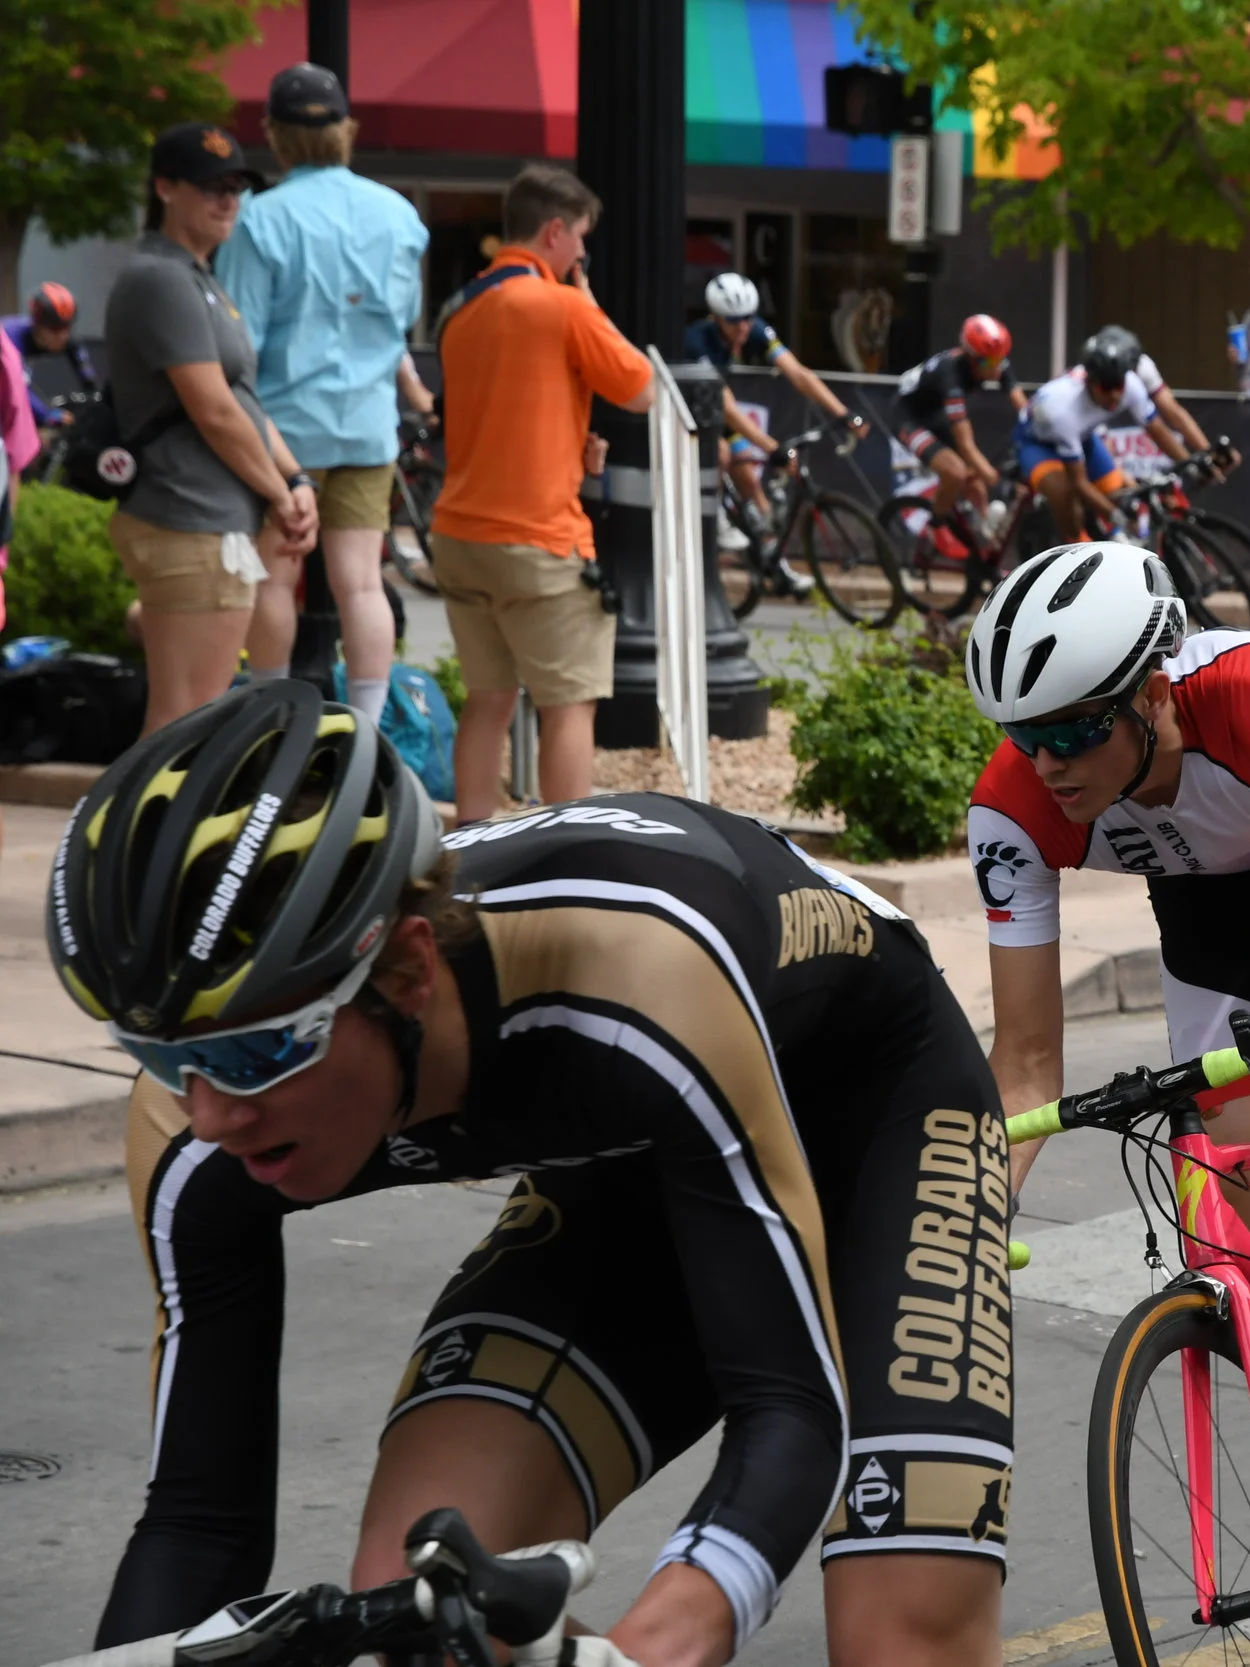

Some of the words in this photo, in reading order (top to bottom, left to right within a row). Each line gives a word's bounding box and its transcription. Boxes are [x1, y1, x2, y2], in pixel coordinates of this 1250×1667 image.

[1111, 433, 1162, 457] US
[188, 873, 242, 961] COLORADO
[228, 792, 283, 878] BUFFALOES
[1157, 821, 1191, 857] CLUB
[887, 1108, 977, 1402] COLORADO
[967, 1111, 1012, 1419] BUFFALOES
